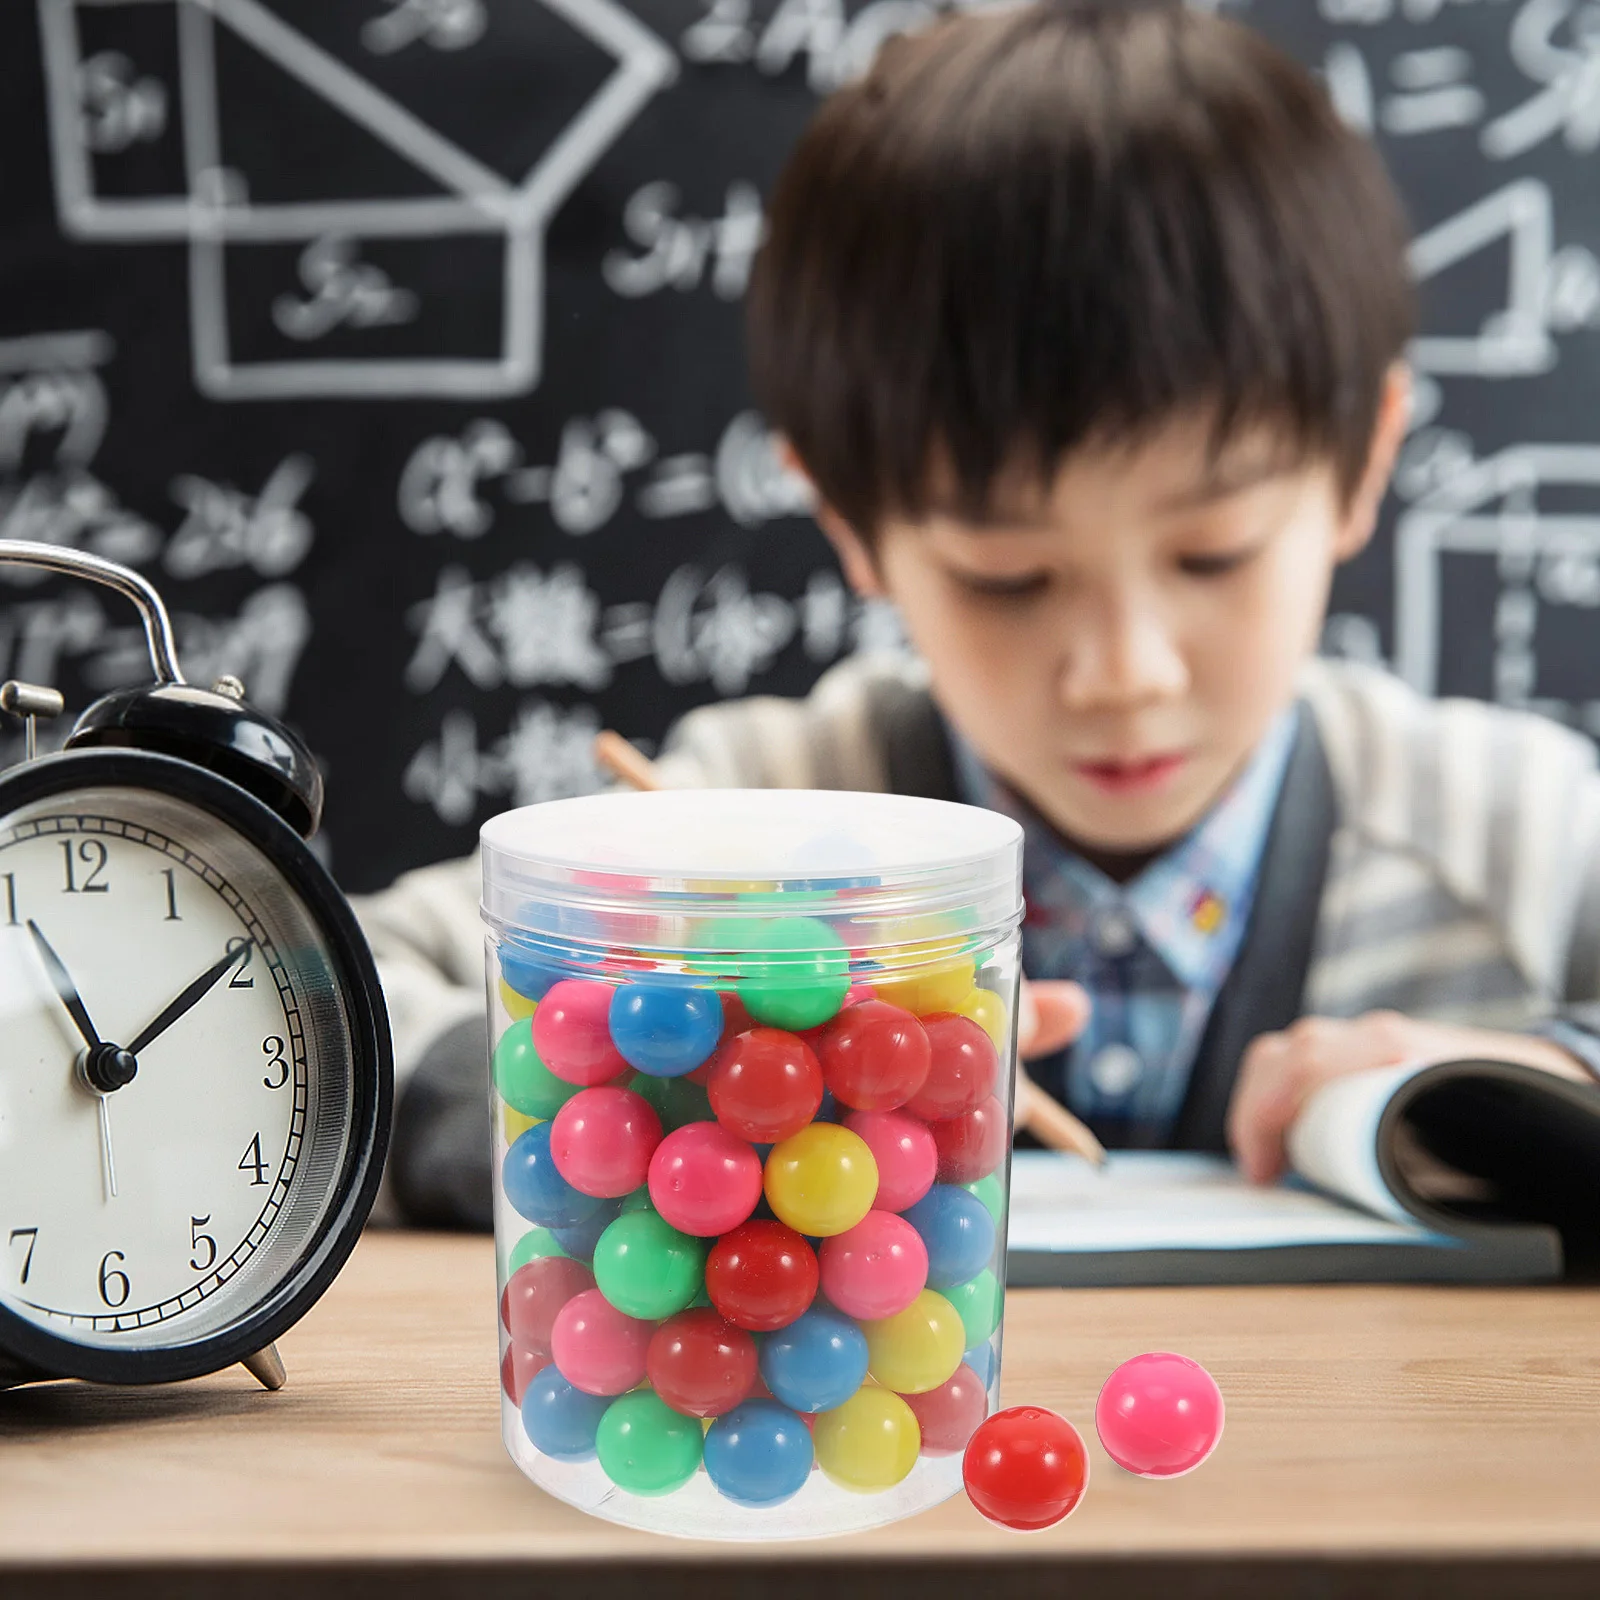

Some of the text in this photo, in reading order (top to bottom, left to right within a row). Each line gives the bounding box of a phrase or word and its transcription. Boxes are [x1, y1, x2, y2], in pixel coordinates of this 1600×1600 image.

[58, 838, 109, 893] 12
[160, 868, 183, 921] 1
[225, 936, 254, 988] 2
[262, 1035, 290, 1091] 3
[237, 1131, 270, 1187] 4
[9, 1227, 39, 1285] 7
[189, 1214, 217, 1272] 5
[98, 1250, 131, 1308] 6
